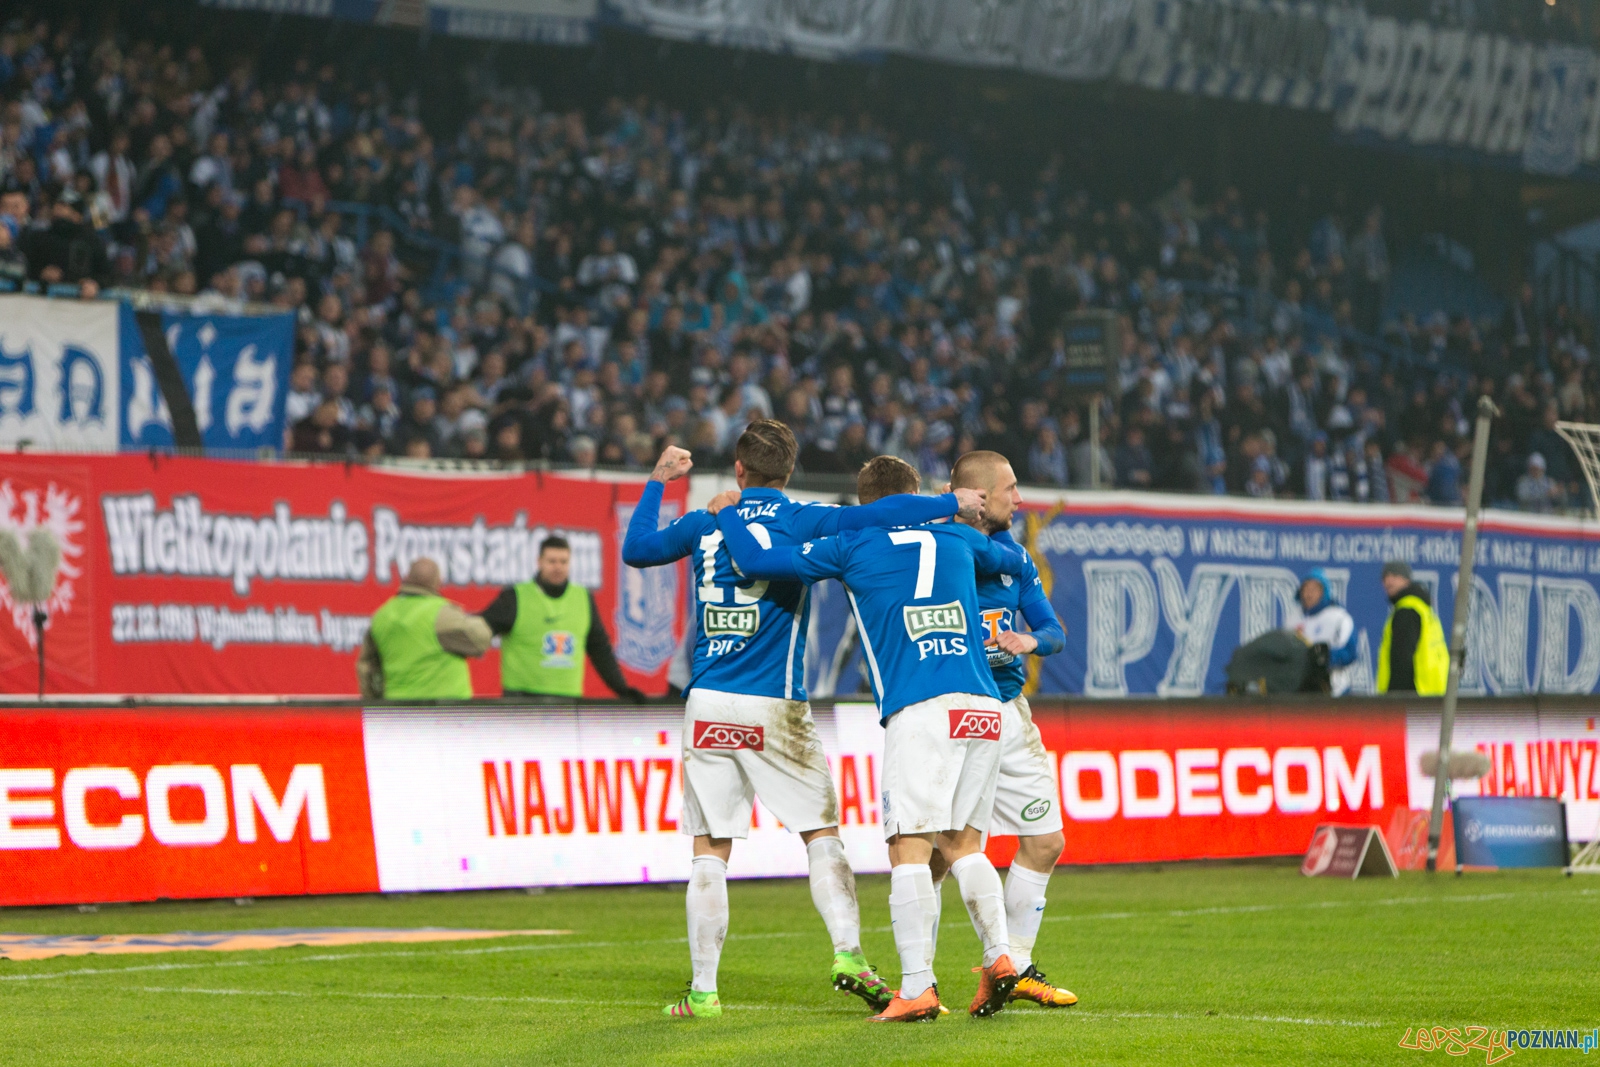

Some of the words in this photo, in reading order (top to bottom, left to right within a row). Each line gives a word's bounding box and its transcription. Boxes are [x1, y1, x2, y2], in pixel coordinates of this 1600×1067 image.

[102, 493, 369, 595] Wielkopolanie
[373, 504, 602, 591] Powstańcm
[888, 530, 936, 599] 7
[708, 611, 754, 630] LECH
[909, 609, 960, 631] LECH
[1082, 557, 1600, 698] PYRND
[917, 637, 968, 661] PILS
[1047, 745, 1385, 820] ODECOM
[0, 762, 331, 850] ECOM
[1028, 804, 1047, 816] SGB
[1482, 823, 1557, 840] EKSTRAKLASA
